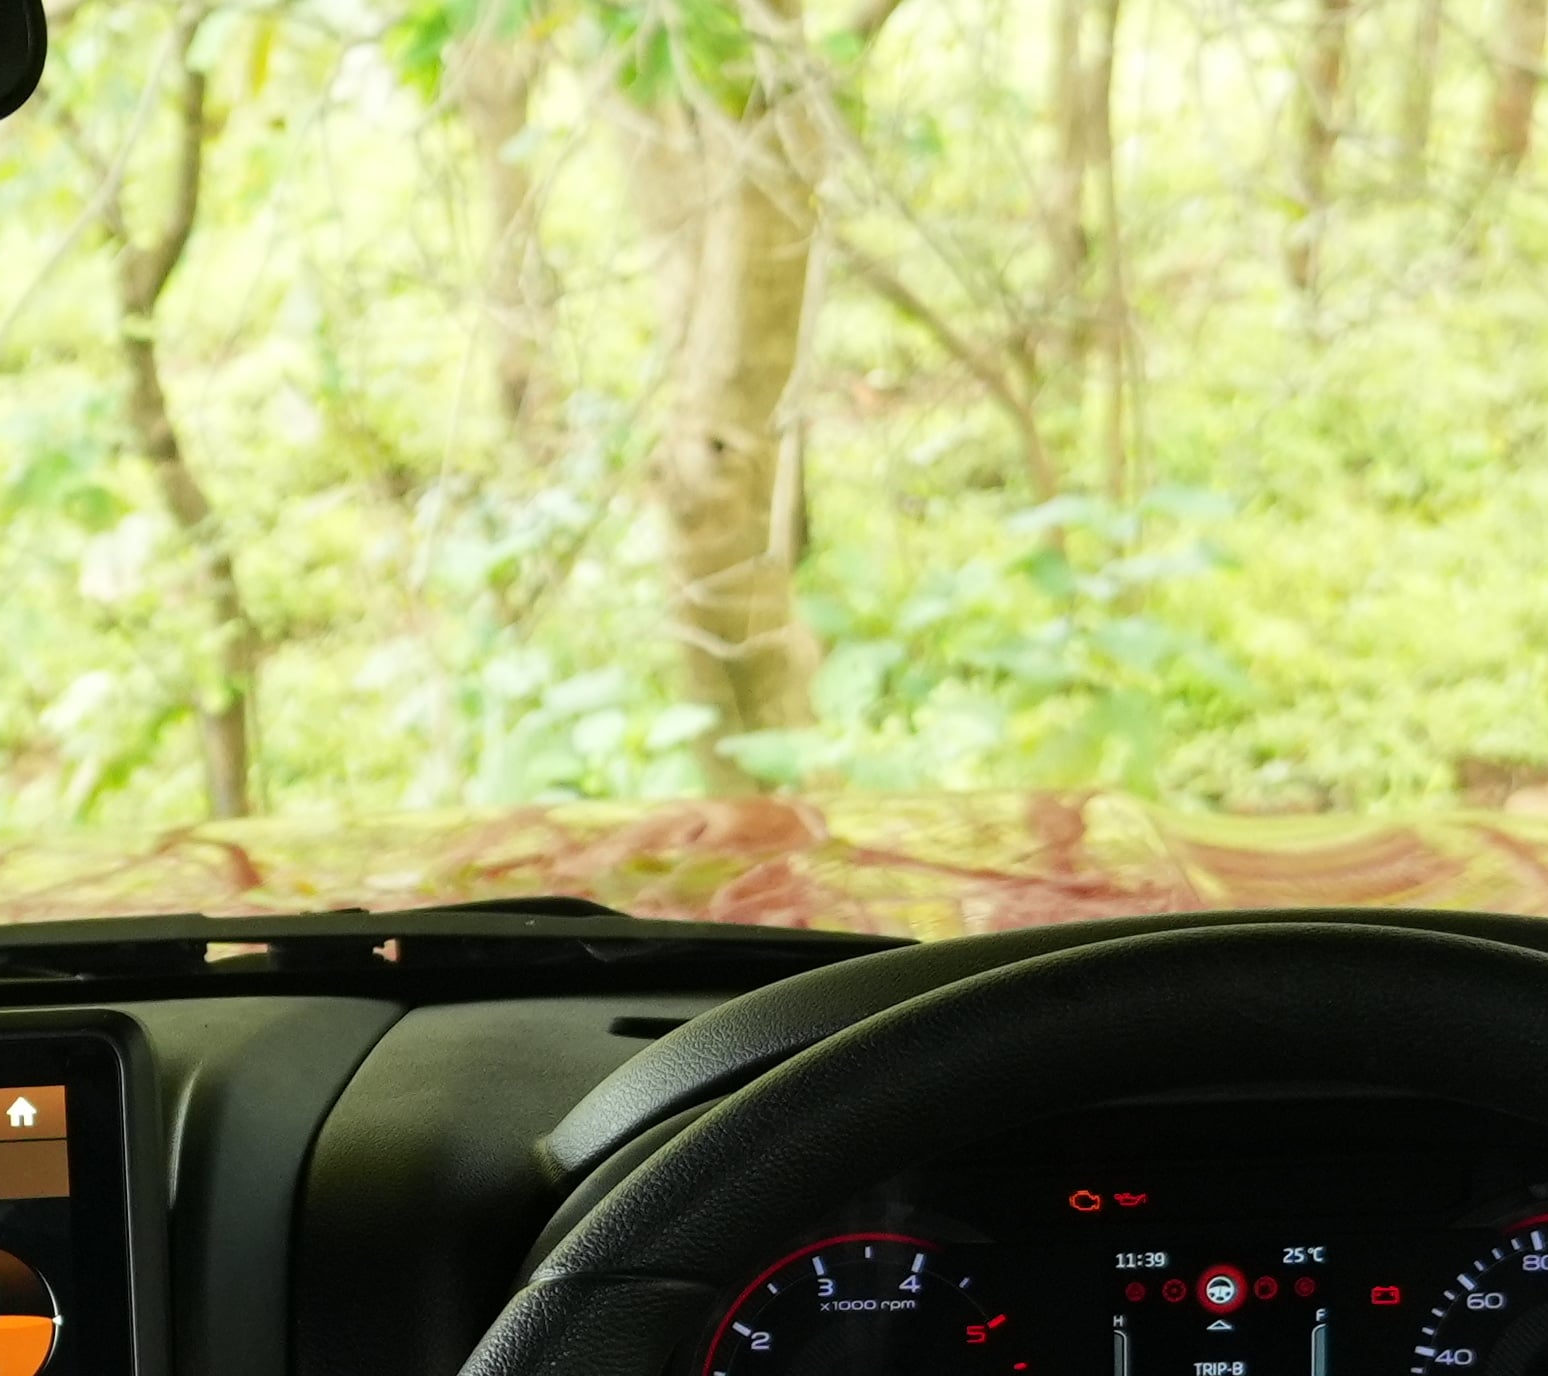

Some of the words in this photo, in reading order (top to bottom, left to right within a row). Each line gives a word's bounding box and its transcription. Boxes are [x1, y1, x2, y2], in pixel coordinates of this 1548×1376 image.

[1115, 1253, 1168, 1269] 11:39
[818, 1279, 834, 1297] 3
[899, 1275, 922, 1294] 4
[880, 1299, 916, 1313] rpm
[1467, 1293, 1503, 1309] 60
[1113, 1315, 1124, 1328] H
[1315, 1309, 1327, 1322] F
[751, 1332, 770, 1350] 2
[966, 1325, 986, 1344] 5
[1435, 1349, 1474, 1365] 40
[1194, 1362, 1244, 1376] TRIP-B
